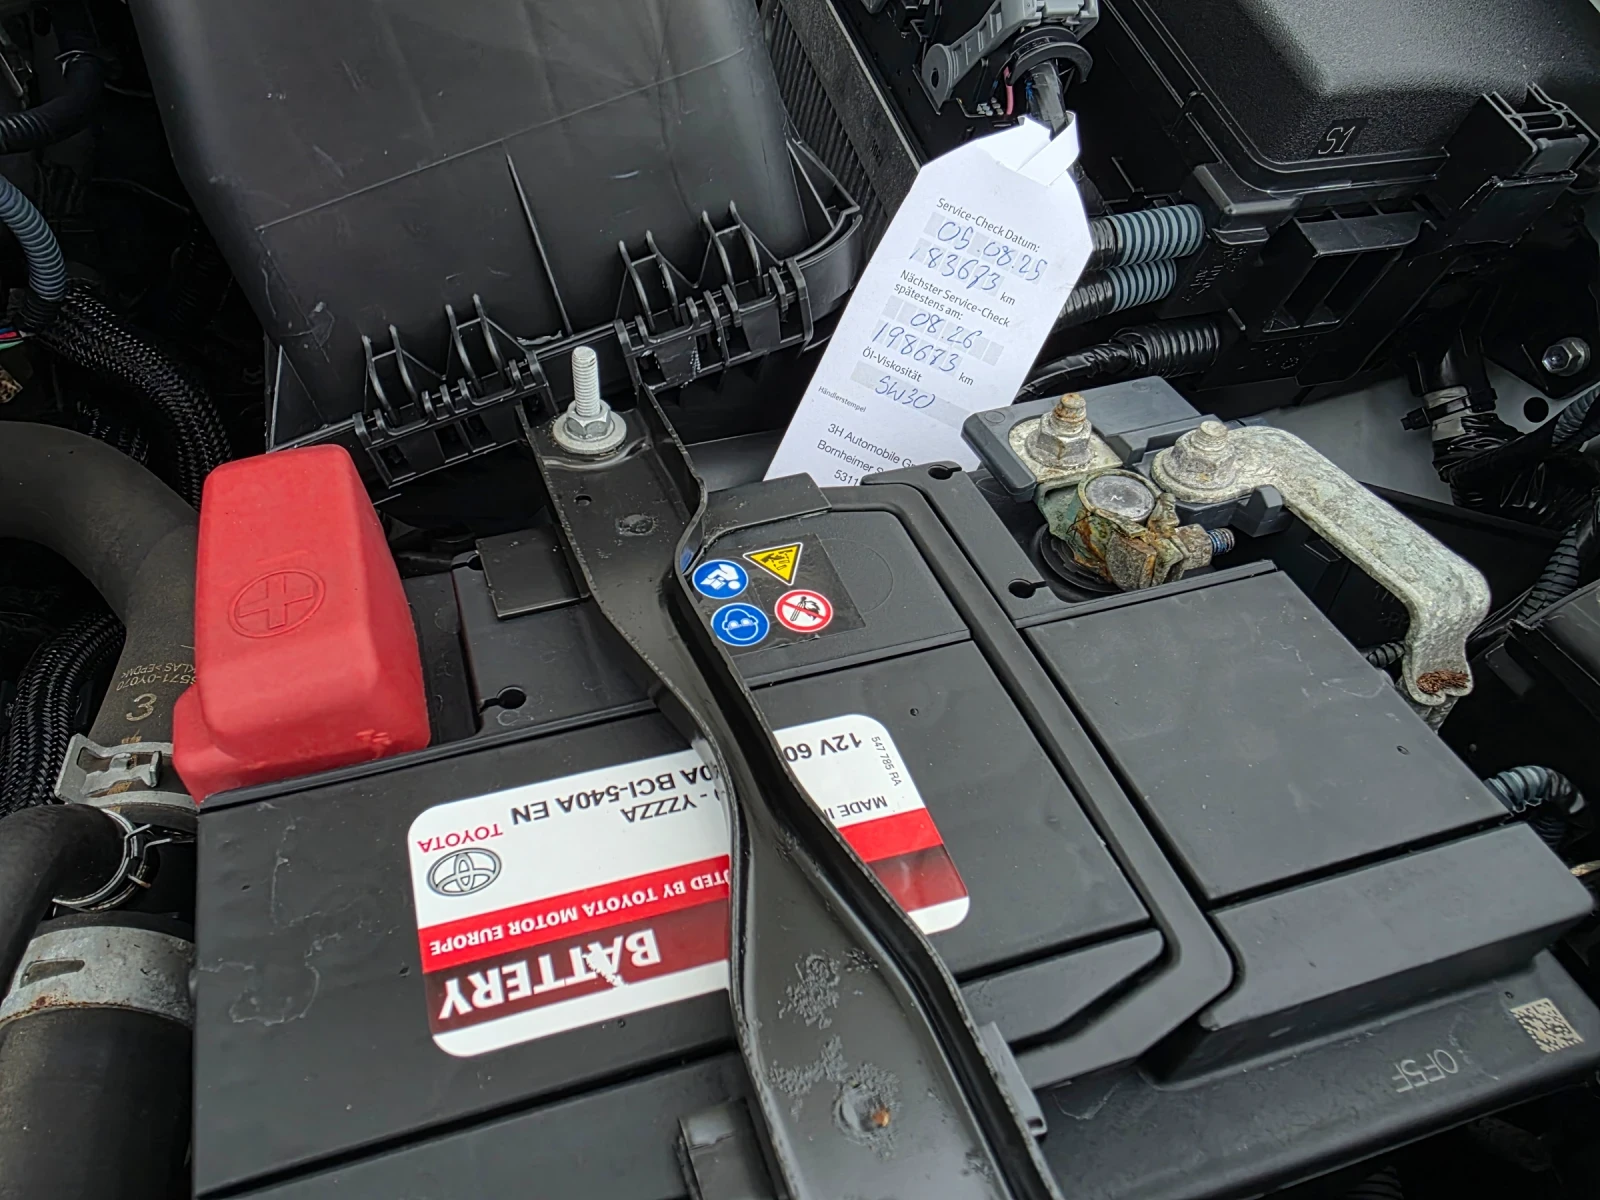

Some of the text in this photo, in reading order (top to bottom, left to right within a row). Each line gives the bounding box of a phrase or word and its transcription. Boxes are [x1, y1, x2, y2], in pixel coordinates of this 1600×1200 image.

[1318, 126, 1356, 154] S1
[936, 198, 1040, 253] Service-Check Datum:
[894, 283, 964, 320] spätestens am:
[900, 269, 1010, 328] Nächster Service-Check
[999, 292, 1016, 306] km
[862, 346, 923, 382] Öl-Viskosität
[872, 322, 974, 386] 198673 km
[818, 386, 867, 413] Händlerstempel
[817, 440, 874, 473] Bornheimer
[828, 423, 844, 437] 3H
[844, 432, 900, 464] Automobile
[784, 732, 862, 762] 12V 60
[871, 736, 902, 787] 547 785 RA
[555, 773, 676, 813] BCI-540A
[837, 795, 888, 818] MADE
[511, 804, 549, 825] EN
[620, 794, 697, 823] YZZZA
[417, 823, 503, 853] TOYOTA
[582, 887, 658, 917] TOYOTA
[663, 880, 686, 898] BY
[508, 906, 578, 936] MOTOR
[429, 925, 504, 956] EUROPE
[438, 928, 661, 1020] BATTERY
